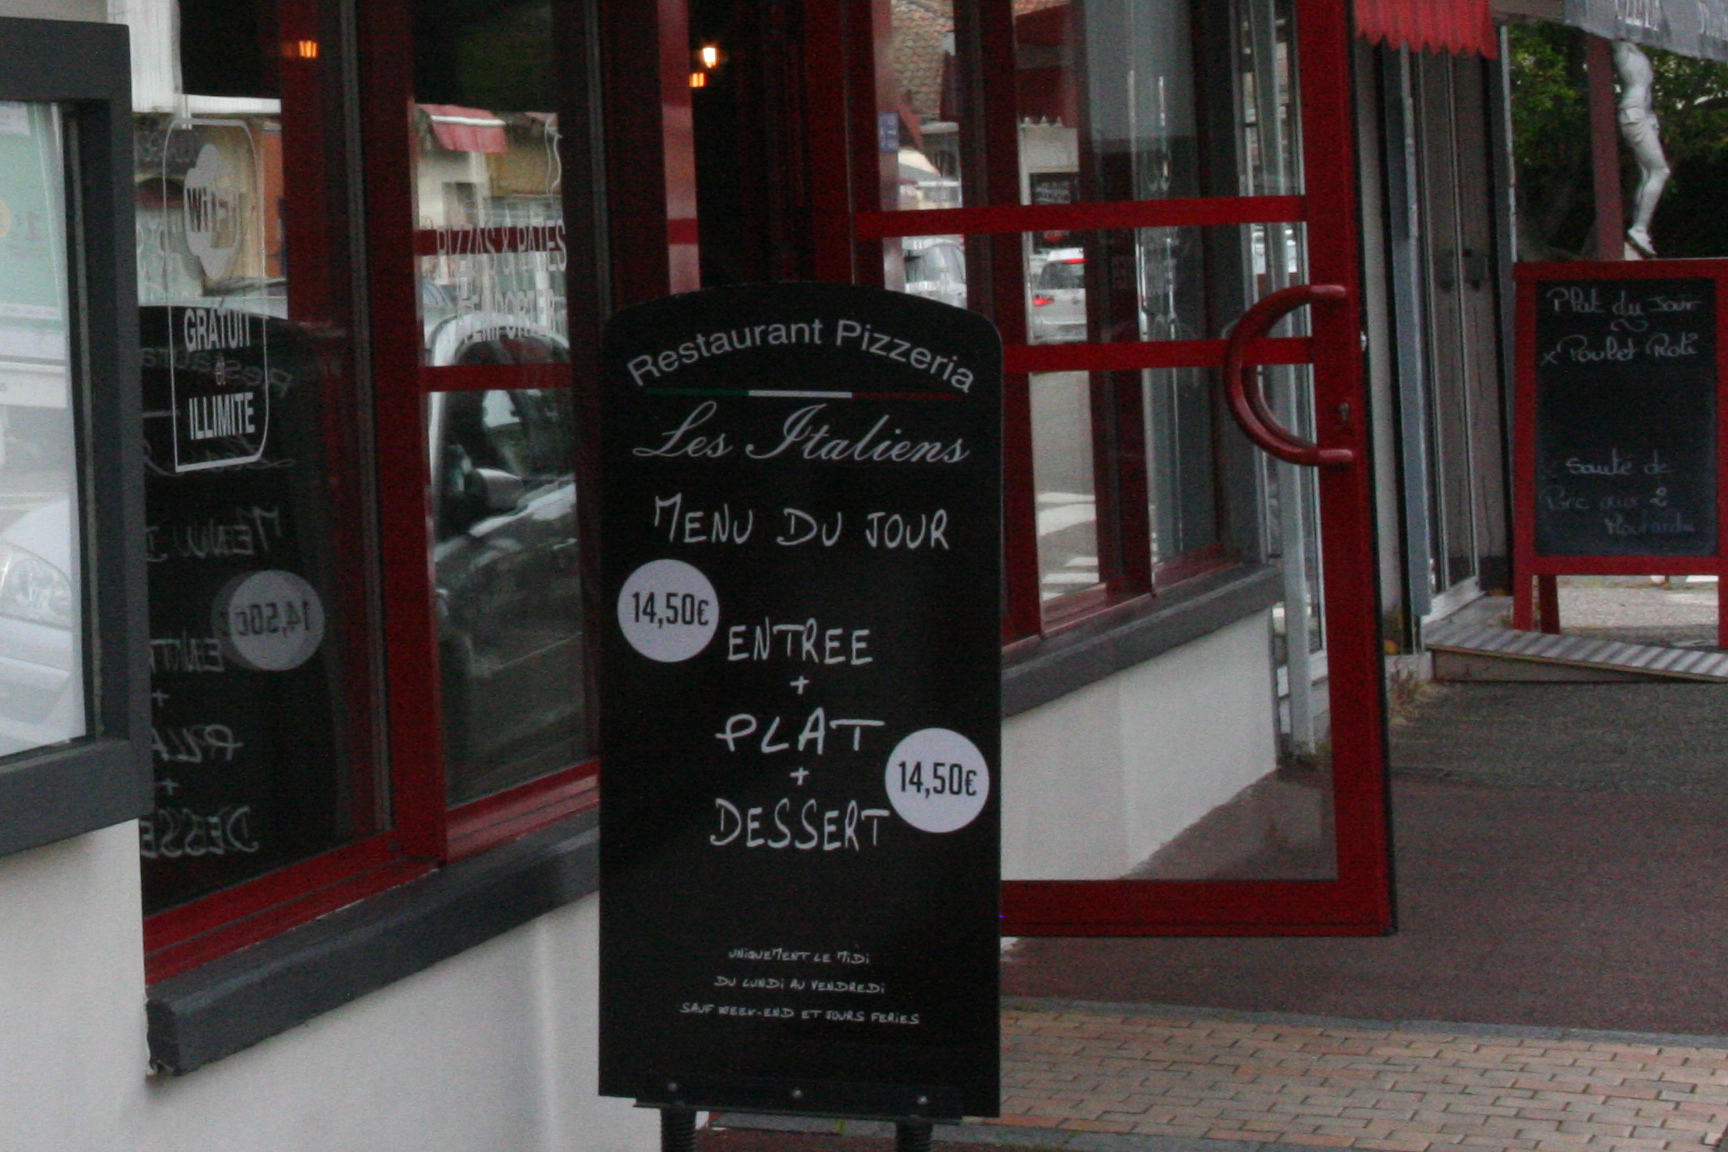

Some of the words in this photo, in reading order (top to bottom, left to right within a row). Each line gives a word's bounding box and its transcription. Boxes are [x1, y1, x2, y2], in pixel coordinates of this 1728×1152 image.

[1611, 289, 1644, 316] du
[184, 307, 251, 352] GRATUIT
[626, 318, 824, 387] Restaurant
[835, 319, 975, 393] Pizzeria
[189, 392, 256, 440] ILLIMITE
[633, 401, 733, 458] Les
[745, 403, 970, 463] Italiens
[653, 493, 754, 544] MENU
[776, 507, 842, 546] DU
[865, 508, 950, 549] JOUR
[632, 591, 710, 629] 14,50€
[728, 616, 874, 665] ENTREE
[715, 707, 886, 755] PLAT
[897, 760, 978, 799] 14,50€
[709, 798, 891, 851] DESSERT
[801, 1009, 822, 1020] ET
